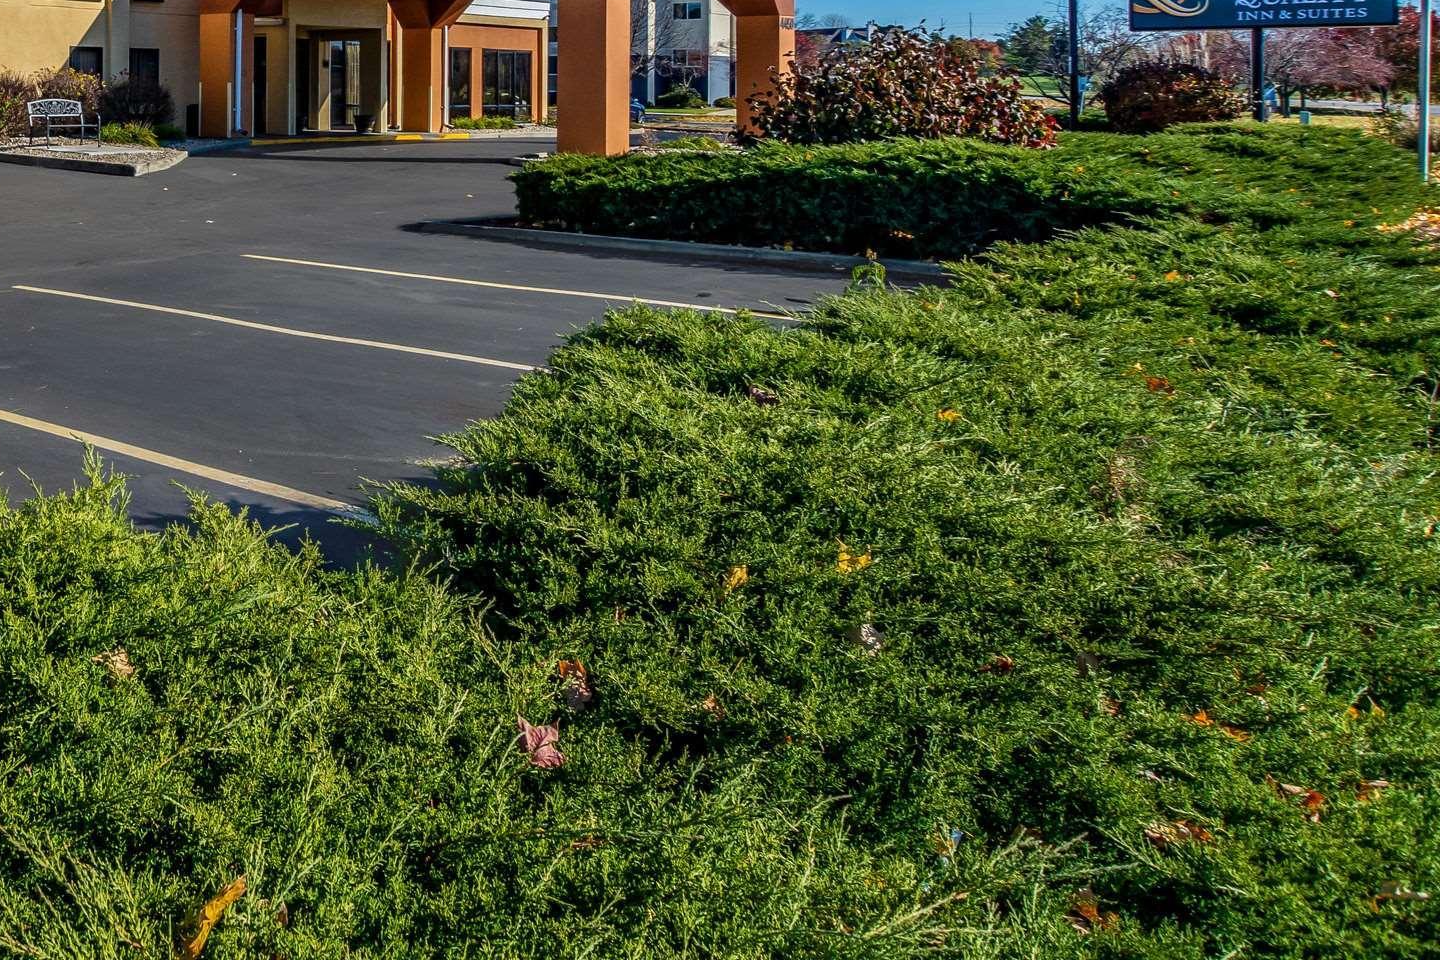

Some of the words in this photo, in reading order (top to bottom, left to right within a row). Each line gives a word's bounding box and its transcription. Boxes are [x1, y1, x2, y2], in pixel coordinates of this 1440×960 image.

[1237, 10, 1273, 21] INN
[1278, 9, 1293, 20] &
[1297, 8, 1368, 19] SUITES
